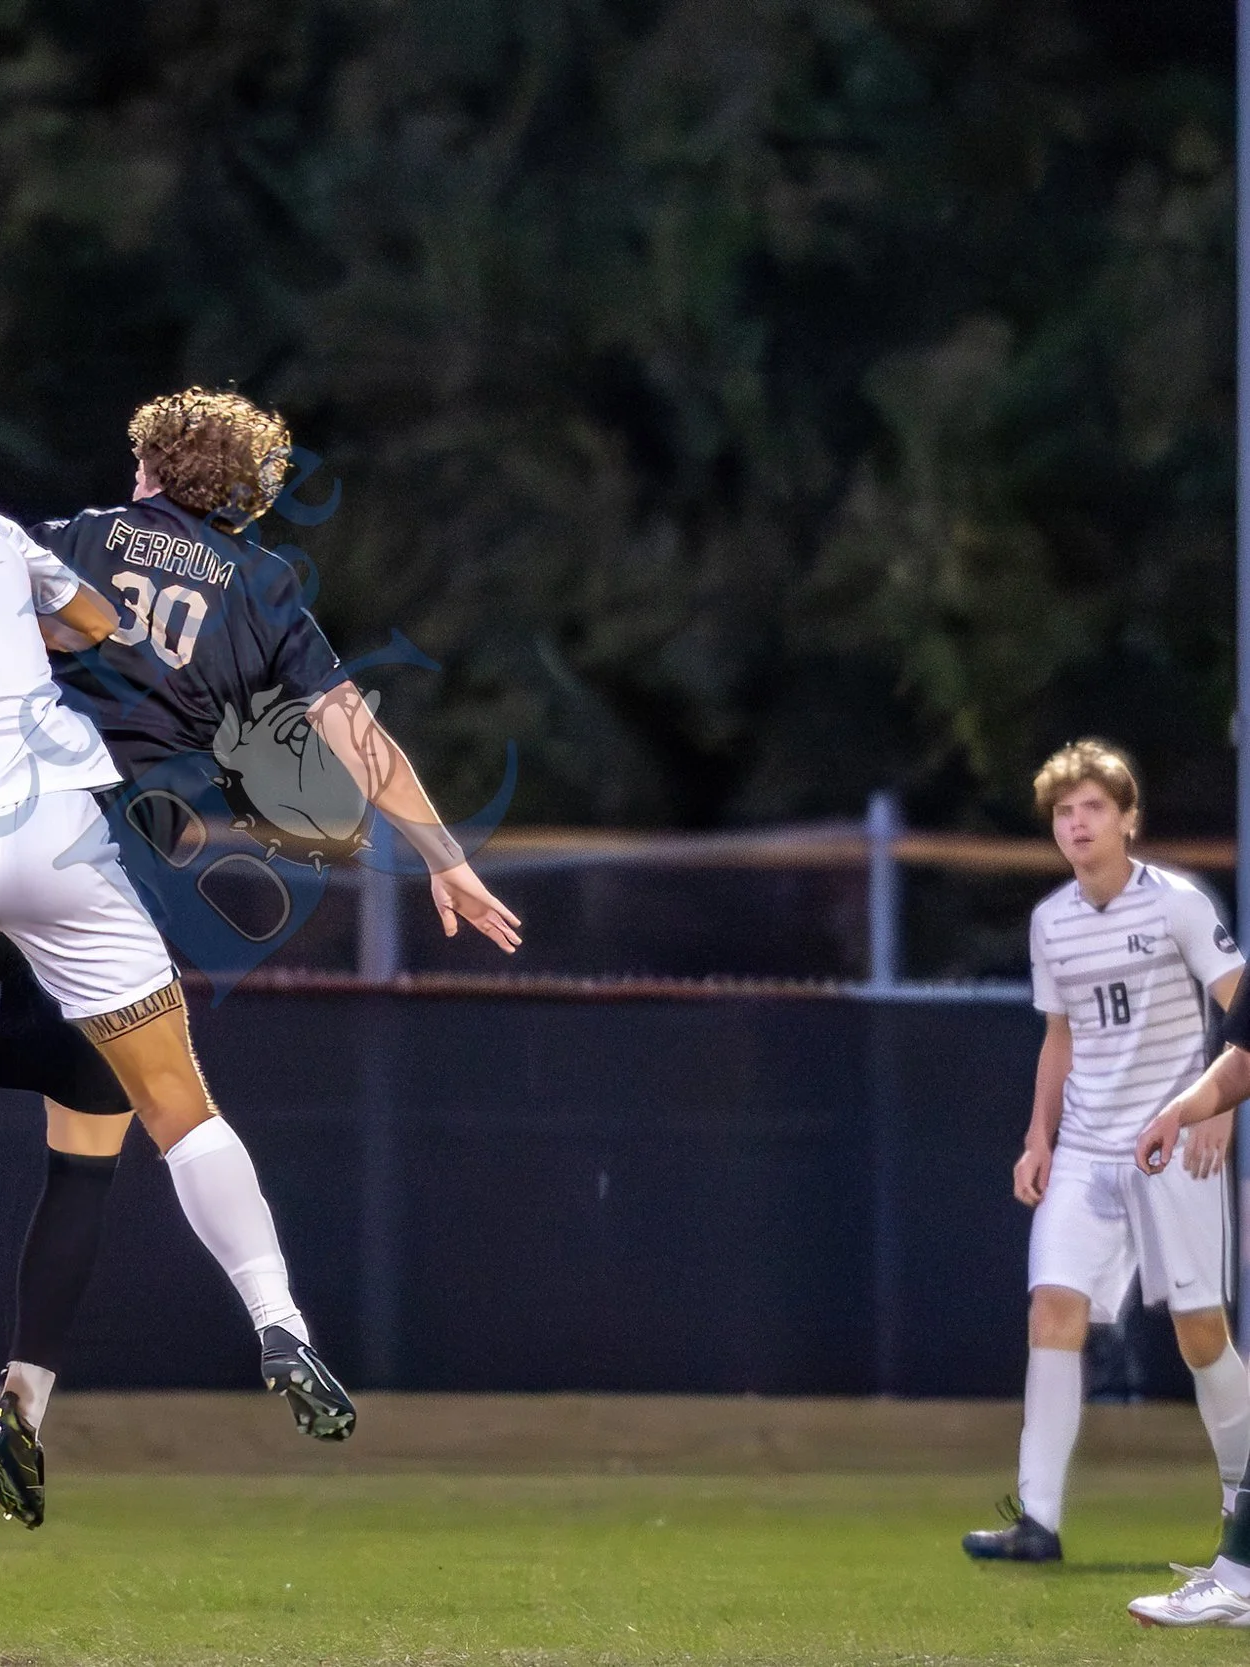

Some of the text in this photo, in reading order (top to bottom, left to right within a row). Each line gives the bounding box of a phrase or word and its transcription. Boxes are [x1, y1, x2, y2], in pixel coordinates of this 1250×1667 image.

[105, 518, 236, 590] FERRUM
[109, 570, 208, 670] 30
[1093, 981, 1130, 1028] 18
